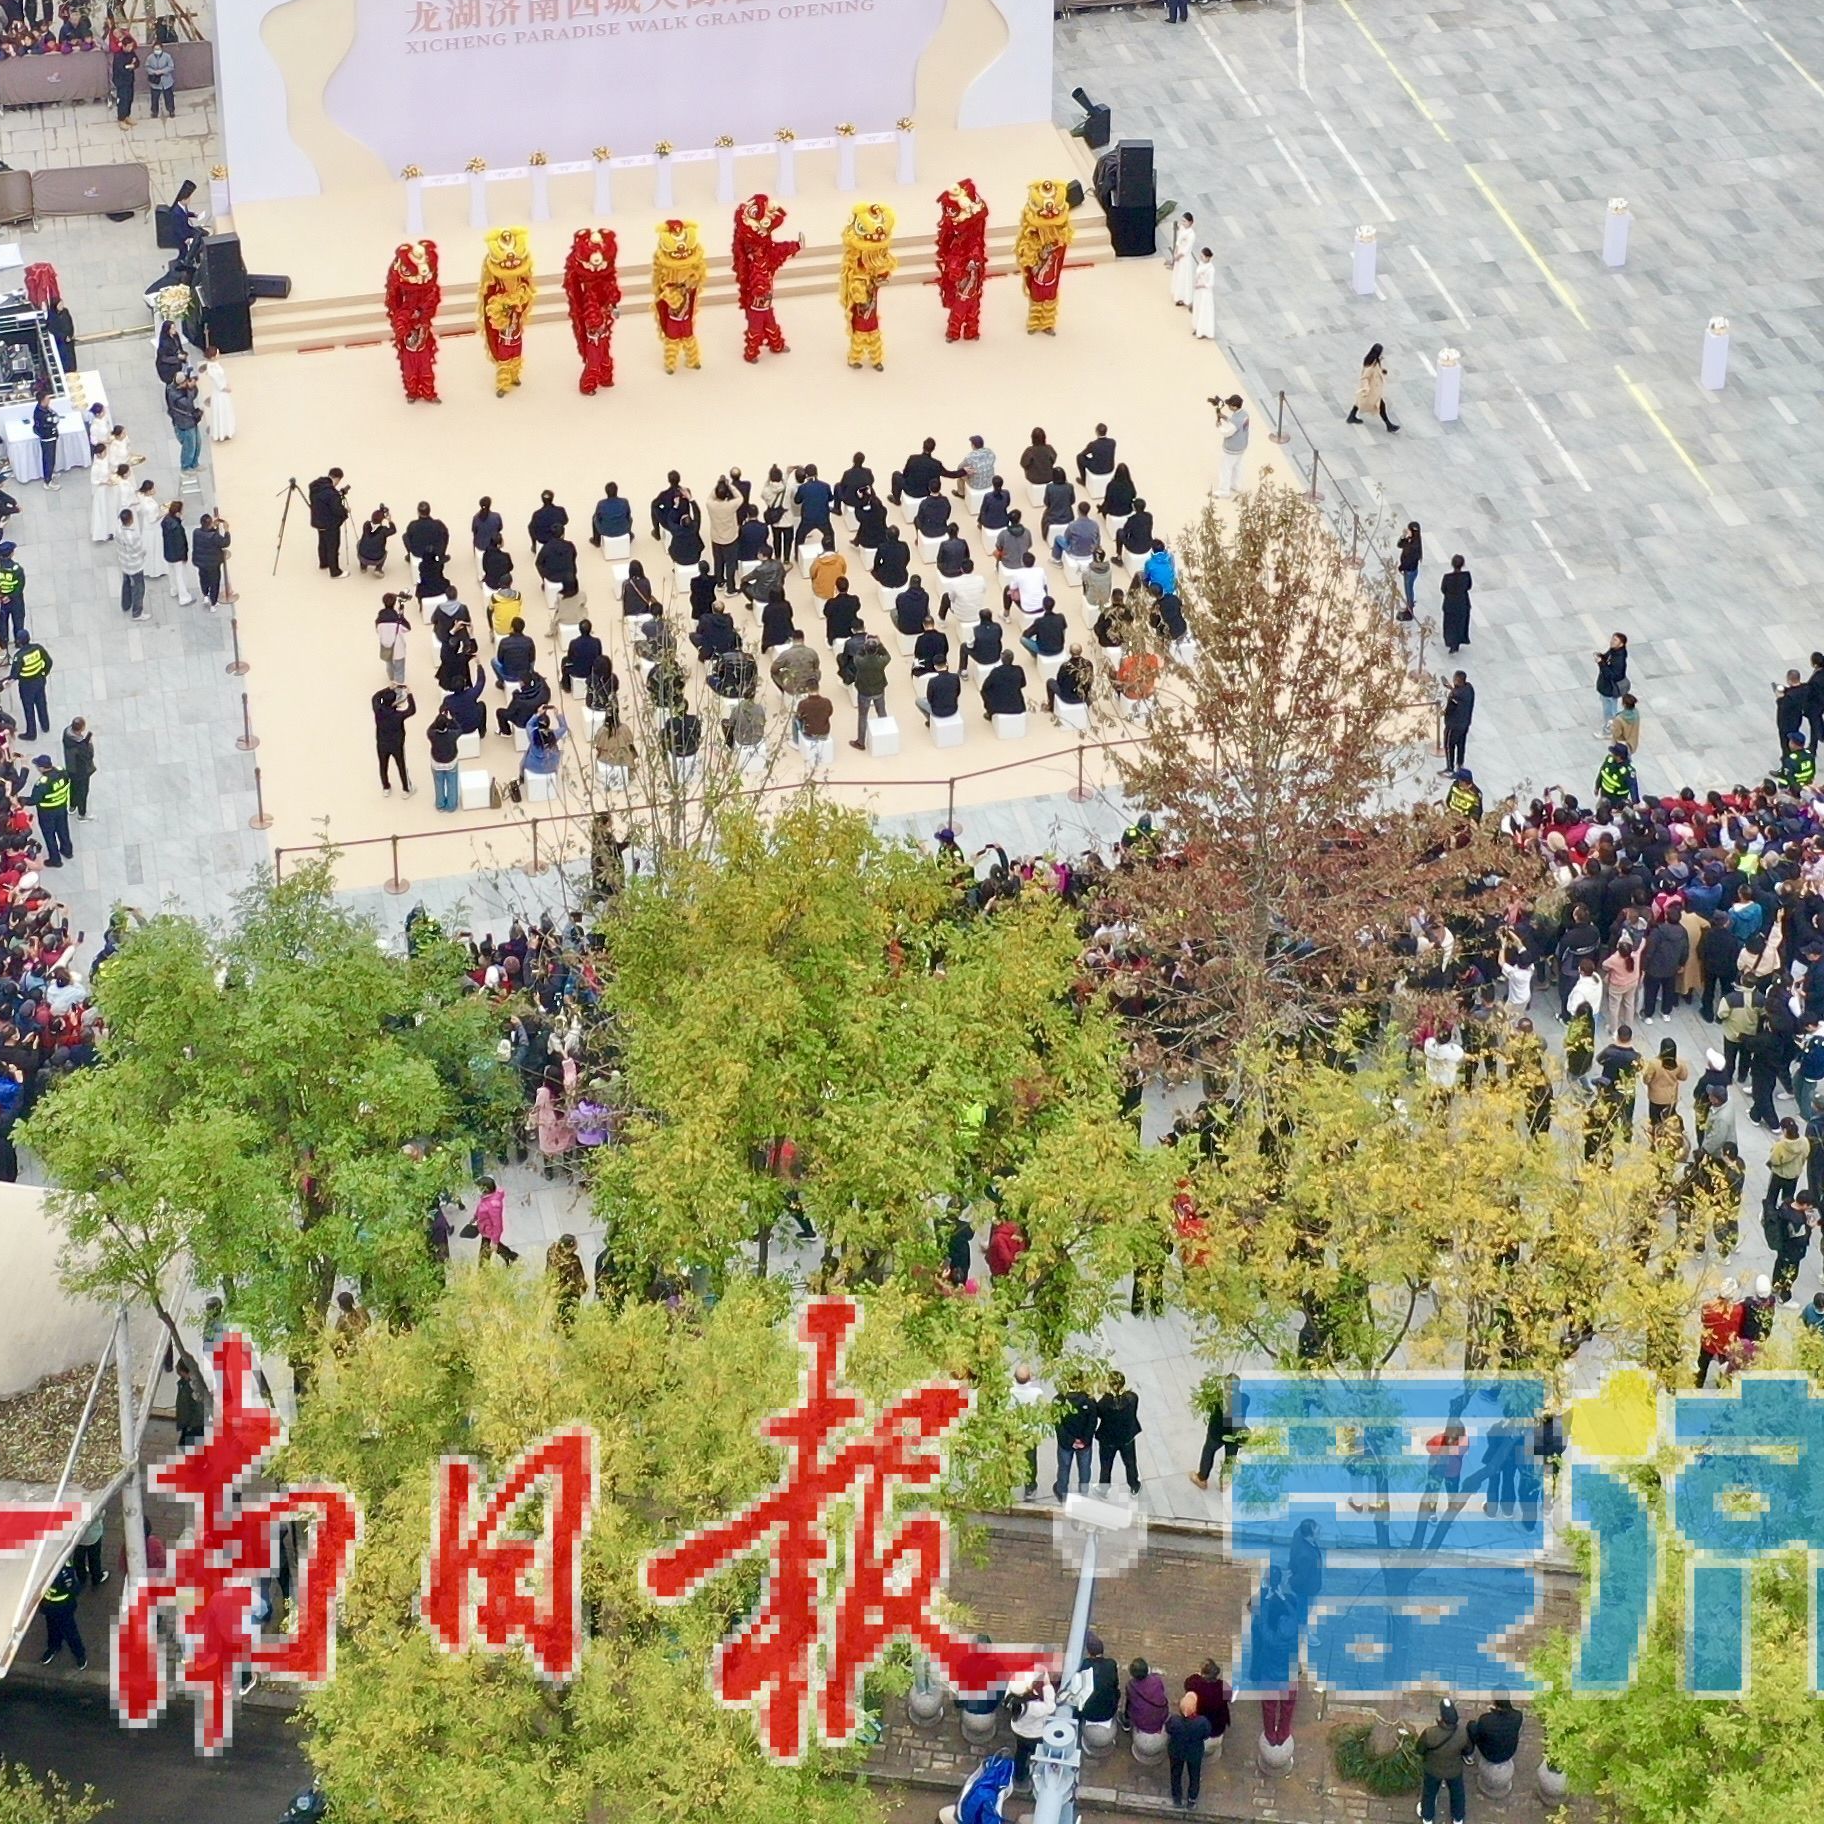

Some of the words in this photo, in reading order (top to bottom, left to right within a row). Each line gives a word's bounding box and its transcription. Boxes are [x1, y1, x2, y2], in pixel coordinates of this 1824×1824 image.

[405, 32, 507, 55] XICHENG
[513, 22, 621, 45] PARADISE
[626, 14, 688, 33] WALK
[695, 7, 771, 27] GRAND
